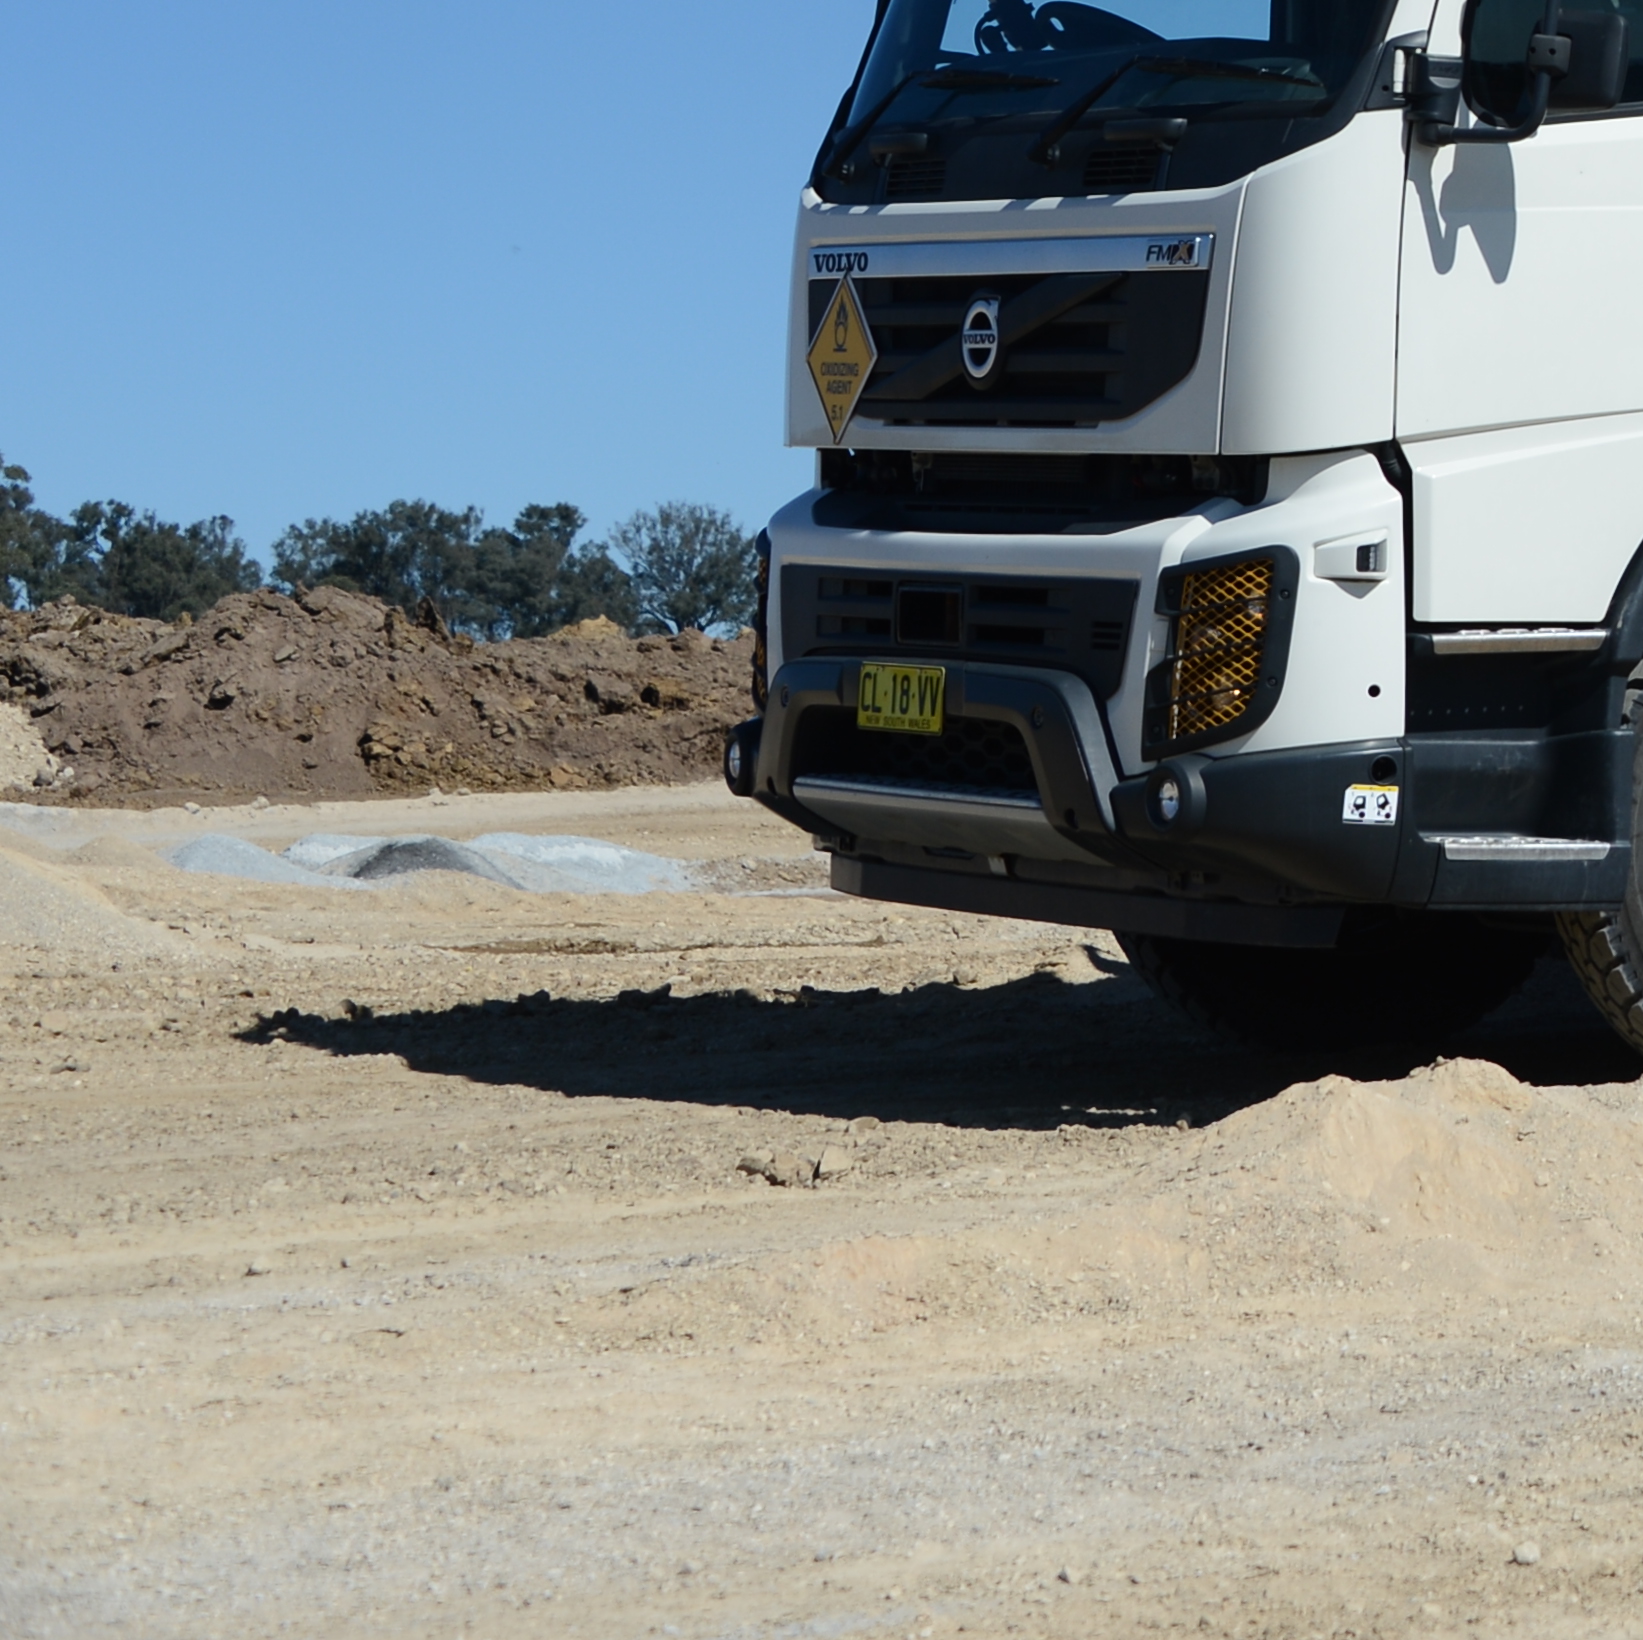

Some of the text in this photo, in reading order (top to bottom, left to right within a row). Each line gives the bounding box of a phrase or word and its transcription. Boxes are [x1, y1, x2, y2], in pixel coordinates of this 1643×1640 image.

[1145, 240, 1195, 265] FMX
[813, 252, 869, 273] VOLVO
[963, 333, 996, 345] VOLVO
[821, 362, 859, 377] OXIDIZING
[826, 380, 852, 395] AGENT
[831, 404, 843, 421] 5.1
